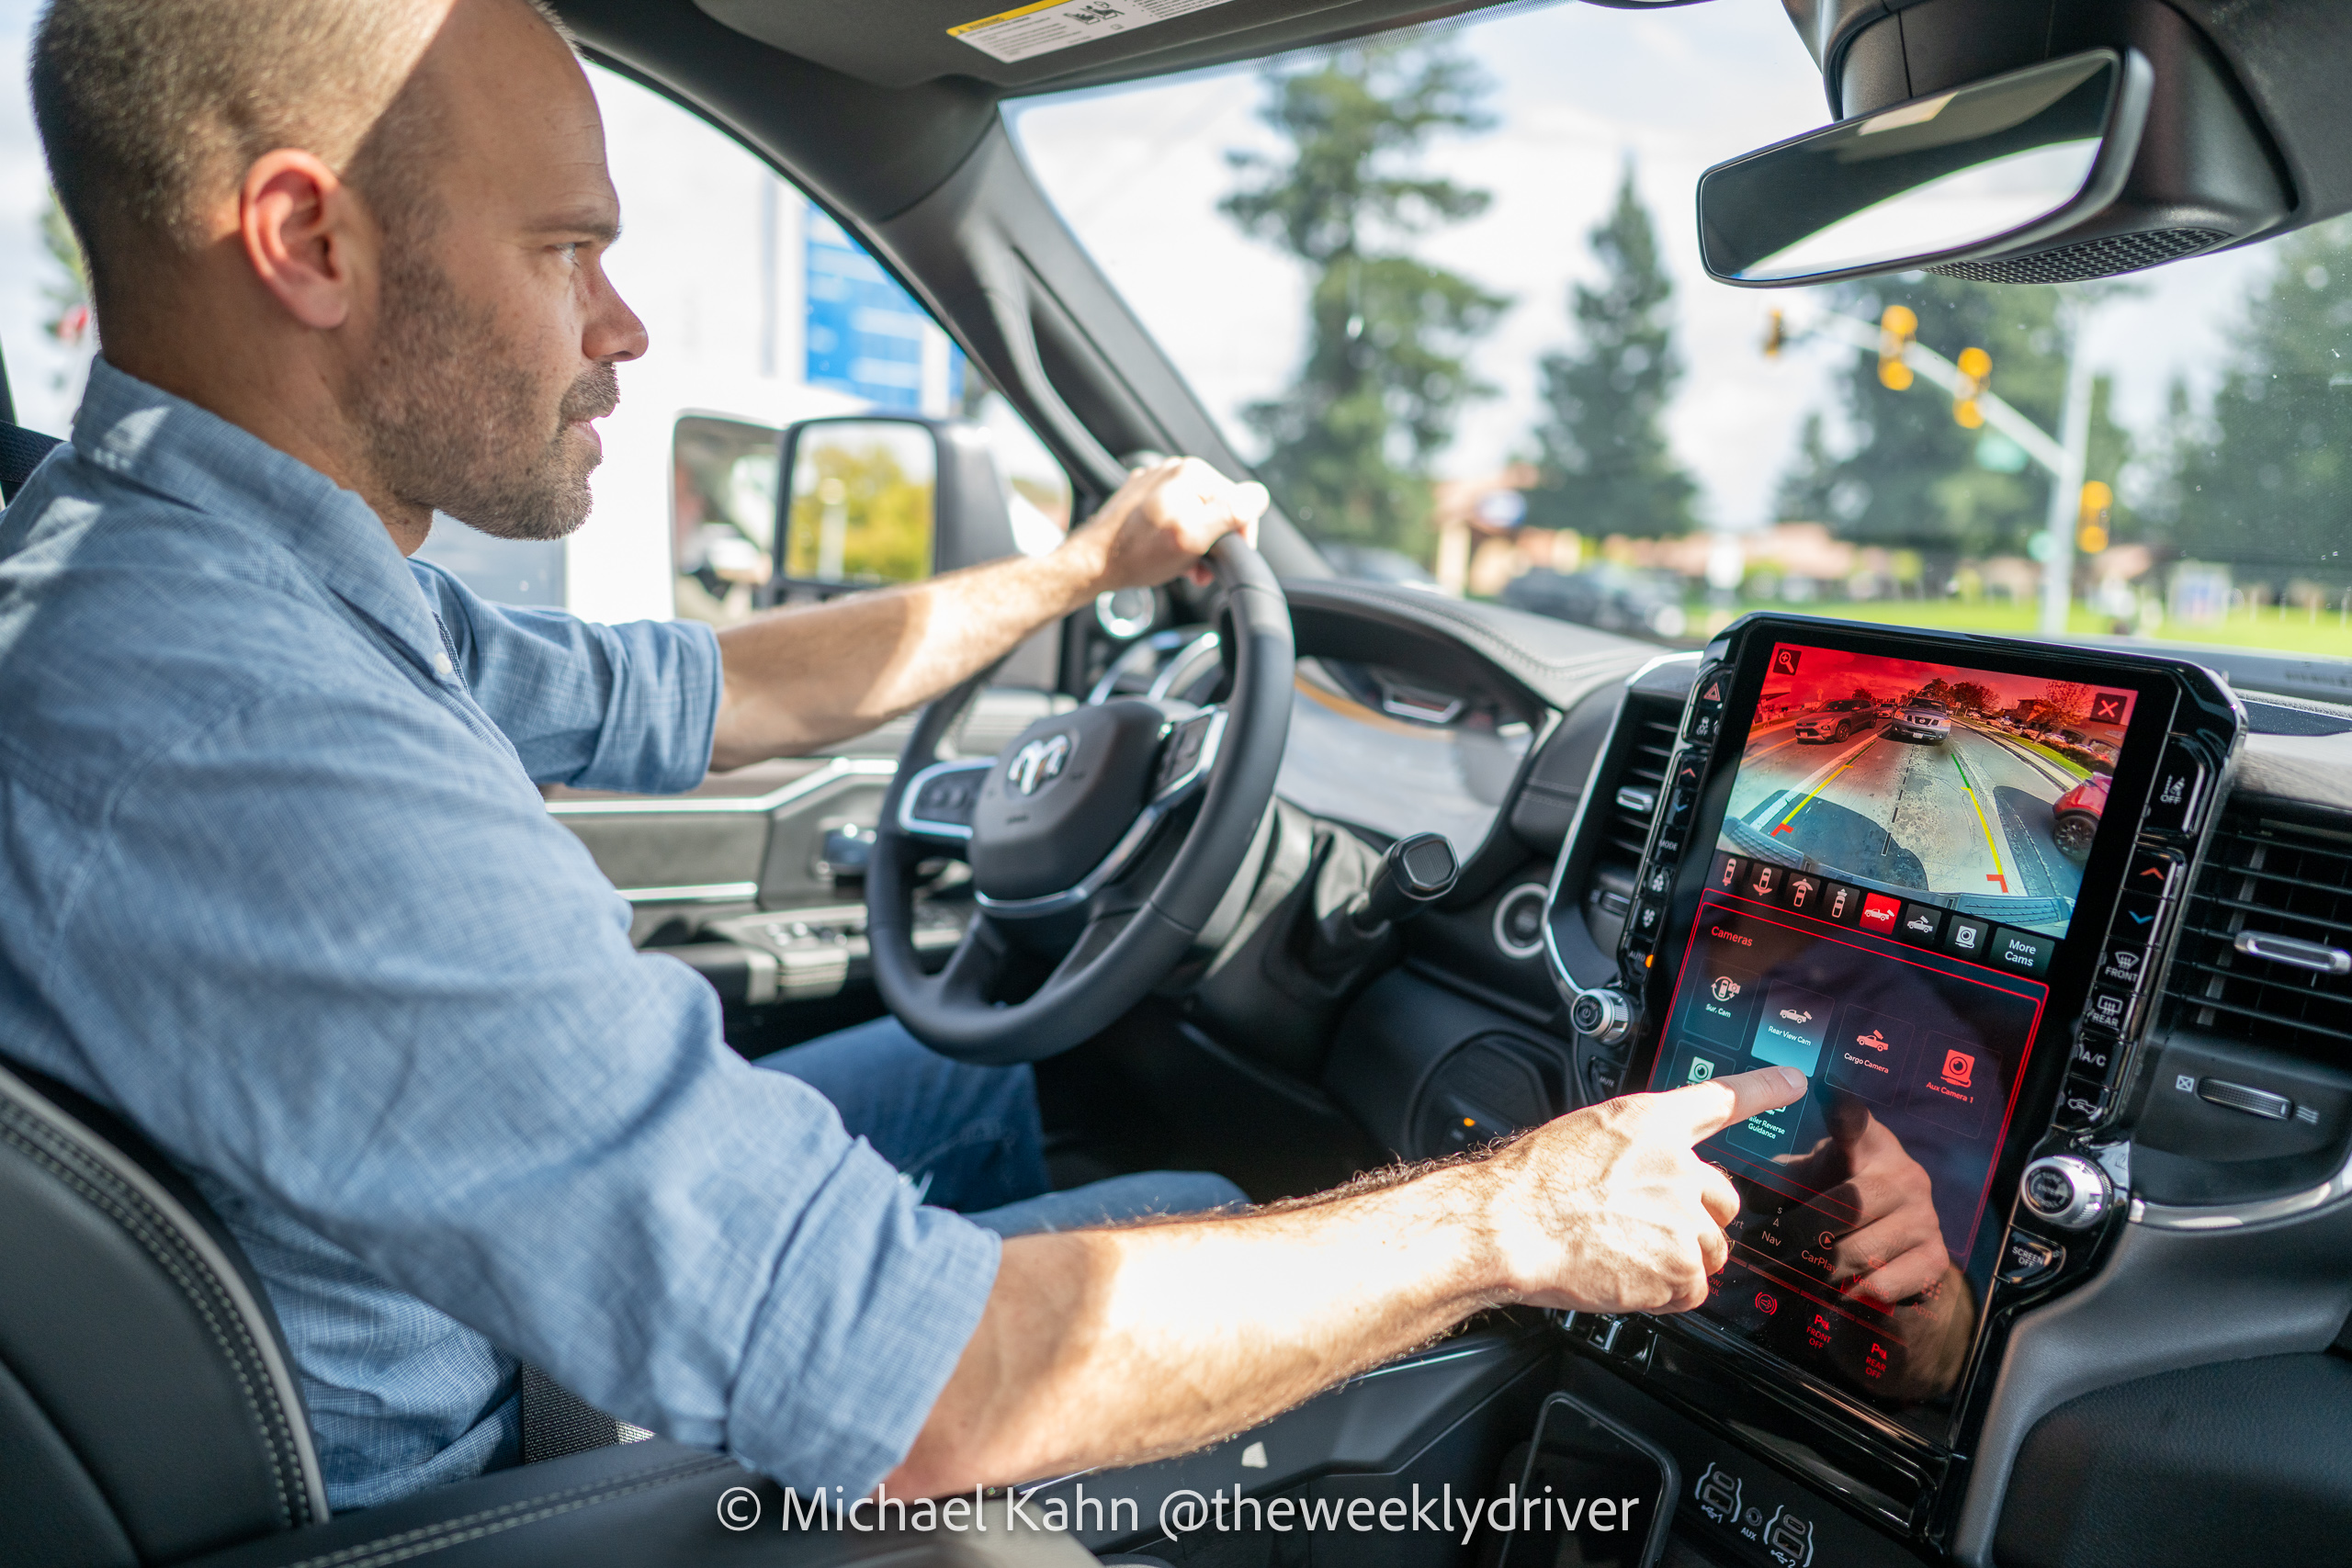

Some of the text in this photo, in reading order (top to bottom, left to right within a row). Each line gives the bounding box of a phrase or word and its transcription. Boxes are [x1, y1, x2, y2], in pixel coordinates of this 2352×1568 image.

[2160, 794, 2182, 806] OFF
[1658, 840, 1679, 852] MODE
[1711, 926, 1753, 947] Cameras
[2008, 939, 2037, 954] More
[1629, 950, 1645, 963] AUTO
[2005, 951, 2034, 967] Cams
[2105, 966, 2138, 982] FRONT
[1717, 1008, 1732, 1019] Cam
[2093, 1012, 2120, 1027] REAR
[1768, 1025, 1812, 1046] Rear View Cam
[1844, 1053, 1889, 1074] Cargo Camera
[2082, 1051, 2107, 1067] A/C
[1600, 1076, 1615, 1088] MUTE
[1926, 1081, 1973, 1104] Aux Camera 1
[1747, 1122, 1776, 1139] Guidance
[1761, 1120, 1785, 1134] Reverse
[1761, 1230, 1781, 1247] Nav
[1802, 1249, 1838, 1274] CarPlay
[2012, 1246, 2043, 1265] SCREEN
[2018, 1256, 2036, 1268] OFF
[1709, 1277, 1724, 1288] OW/
[1853, 1273, 1889, 1299] Vehicle
[1911, 1302, 1939, 1321] Apps
[1806, 1325, 1832, 1343] FRONT
[1809, 1337, 1824, 1348] OFF
[1865, 1356, 1886, 1372] REAR
[1865, 1367, 1882, 1378] OFF
[1741, 1527, 1757, 1541] AUX
